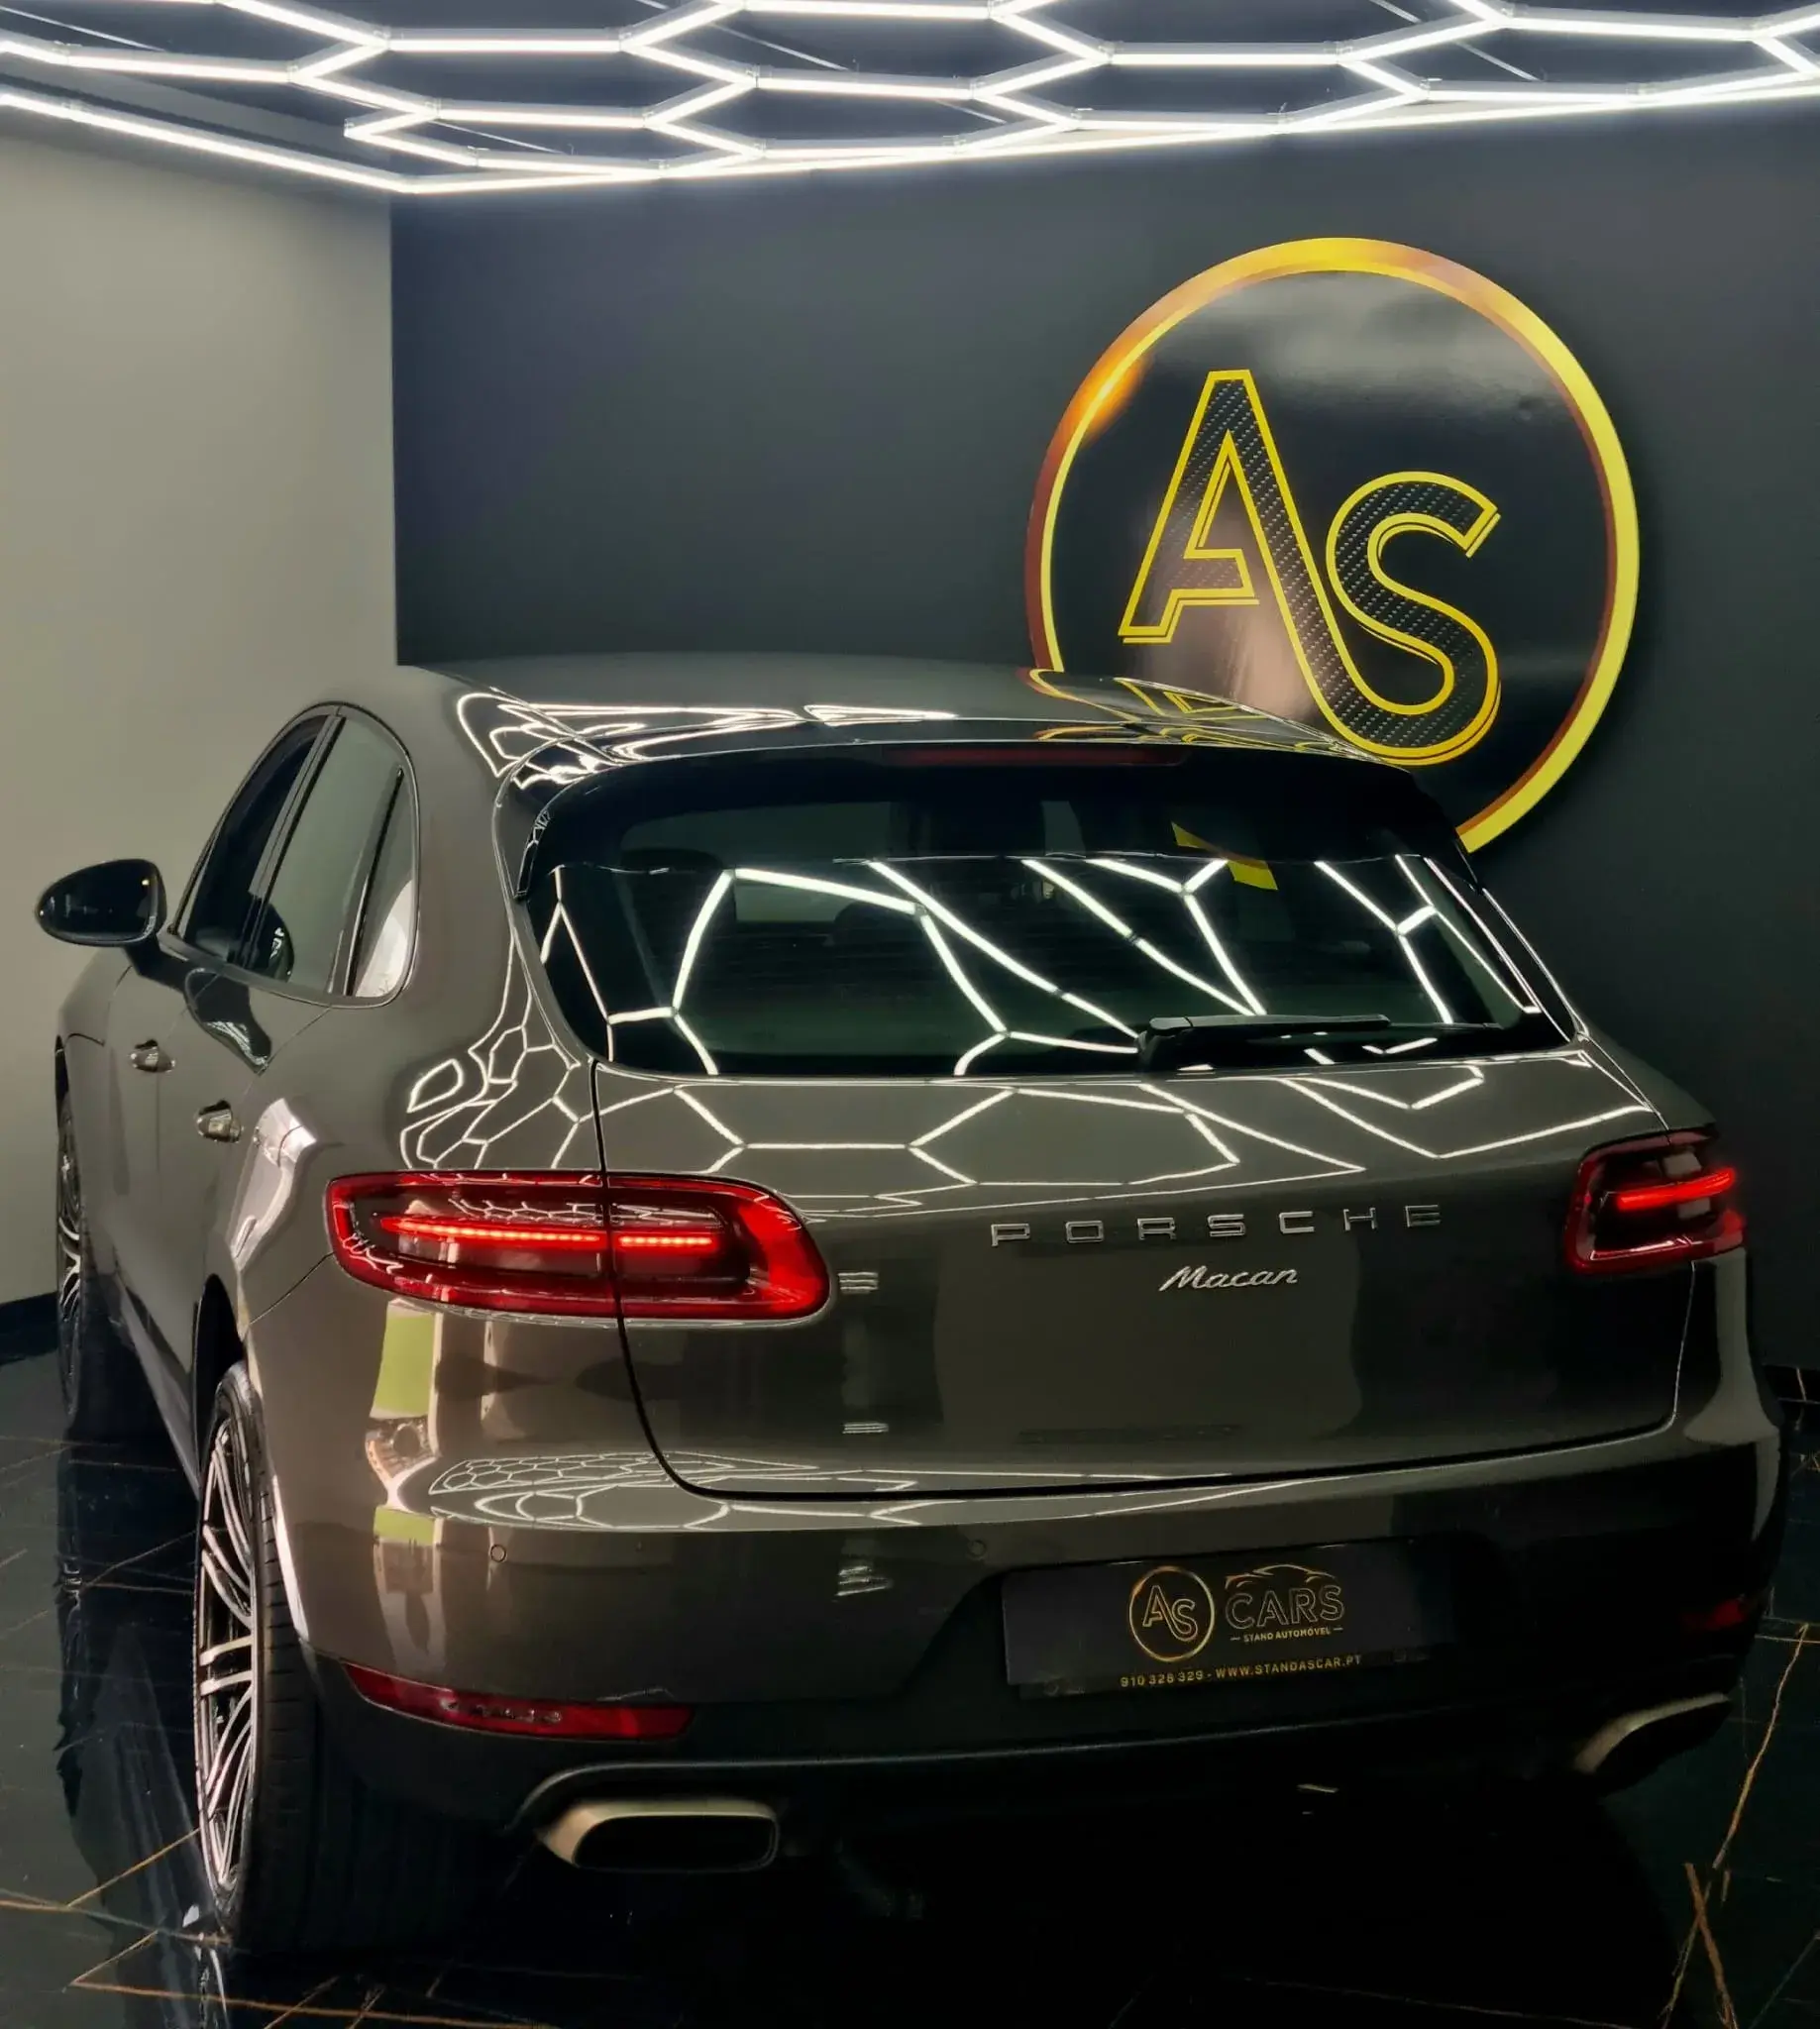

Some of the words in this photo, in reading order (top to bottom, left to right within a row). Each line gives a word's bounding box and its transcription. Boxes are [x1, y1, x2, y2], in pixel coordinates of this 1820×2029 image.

[991, 1205, 1442, 1247] PORSCHE
[1158, 1265, 1298, 1291] Macan
[1225, 1584, 1345, 1630] CARS
[1243, 1631, 1275, 1643] STAND
[1120, 1674, 1145, 1688] 910
[1215, 1654, 1363, 1679] WWW.STANDASCAR.PT
